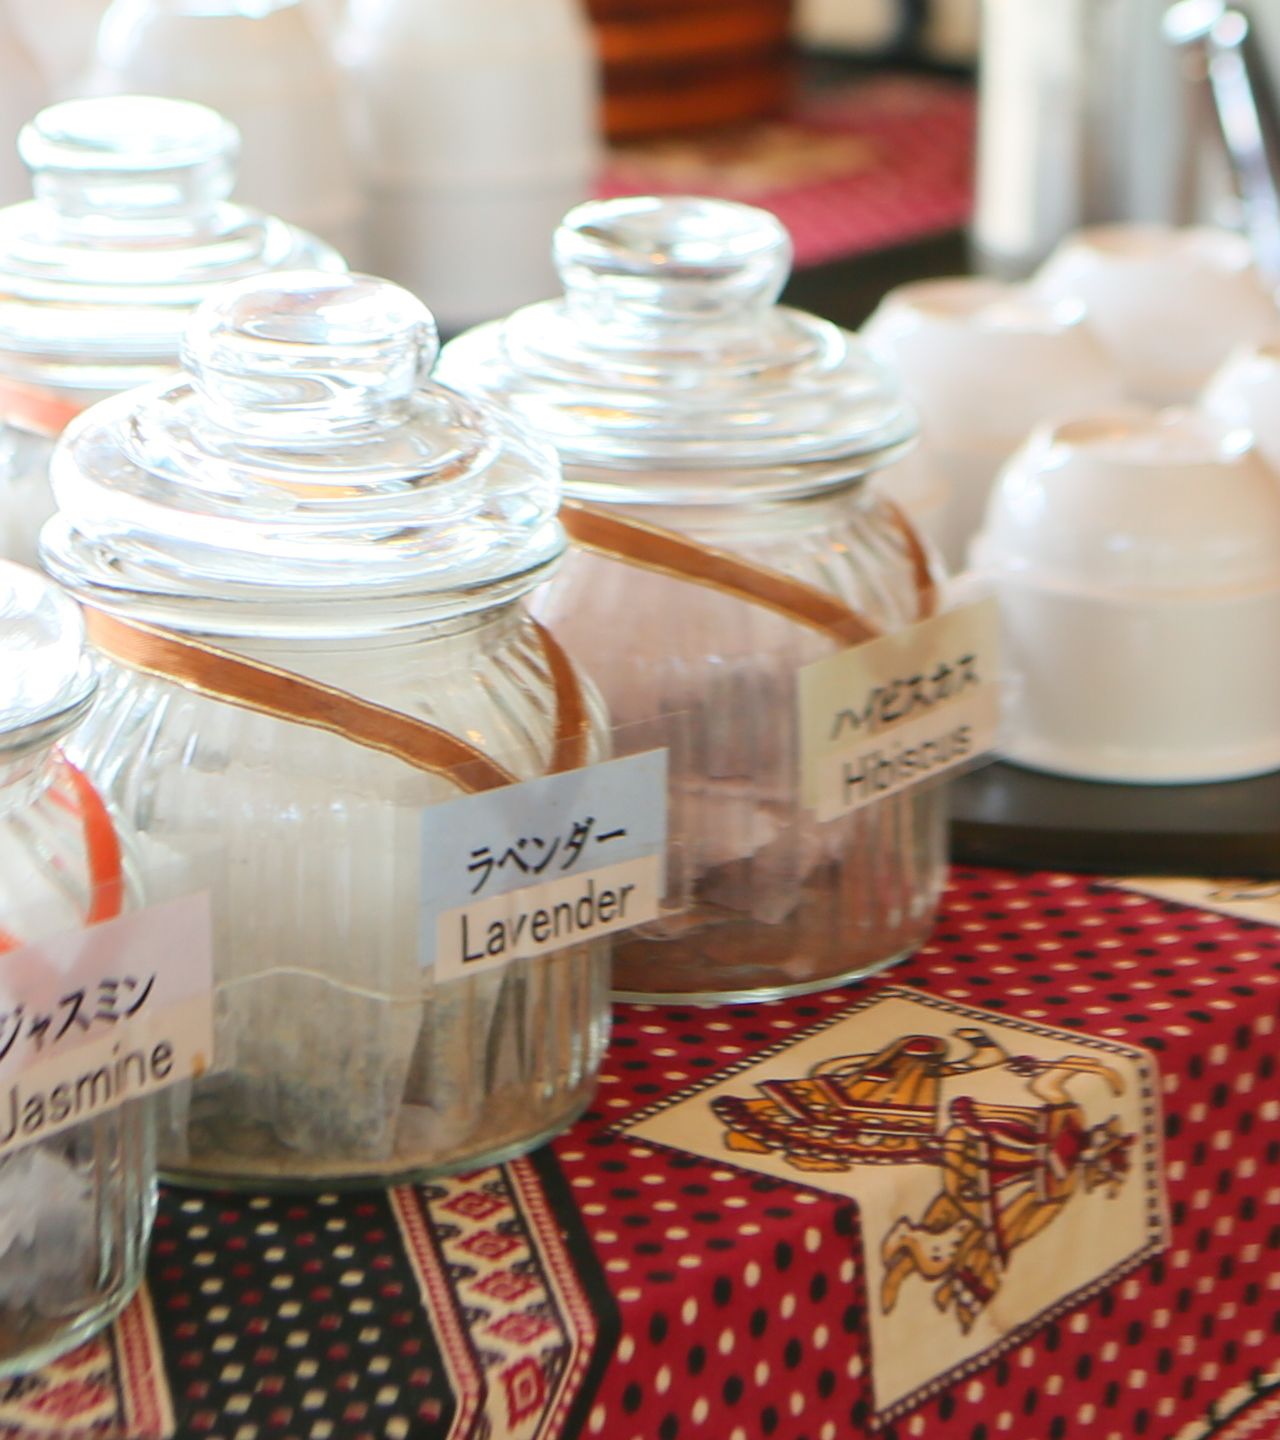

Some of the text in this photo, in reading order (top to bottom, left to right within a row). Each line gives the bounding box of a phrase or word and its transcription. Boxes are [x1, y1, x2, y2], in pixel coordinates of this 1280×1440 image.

[468, 816, 627, 895] ラベンダー
[461, 879, 636, 963] Lavender
